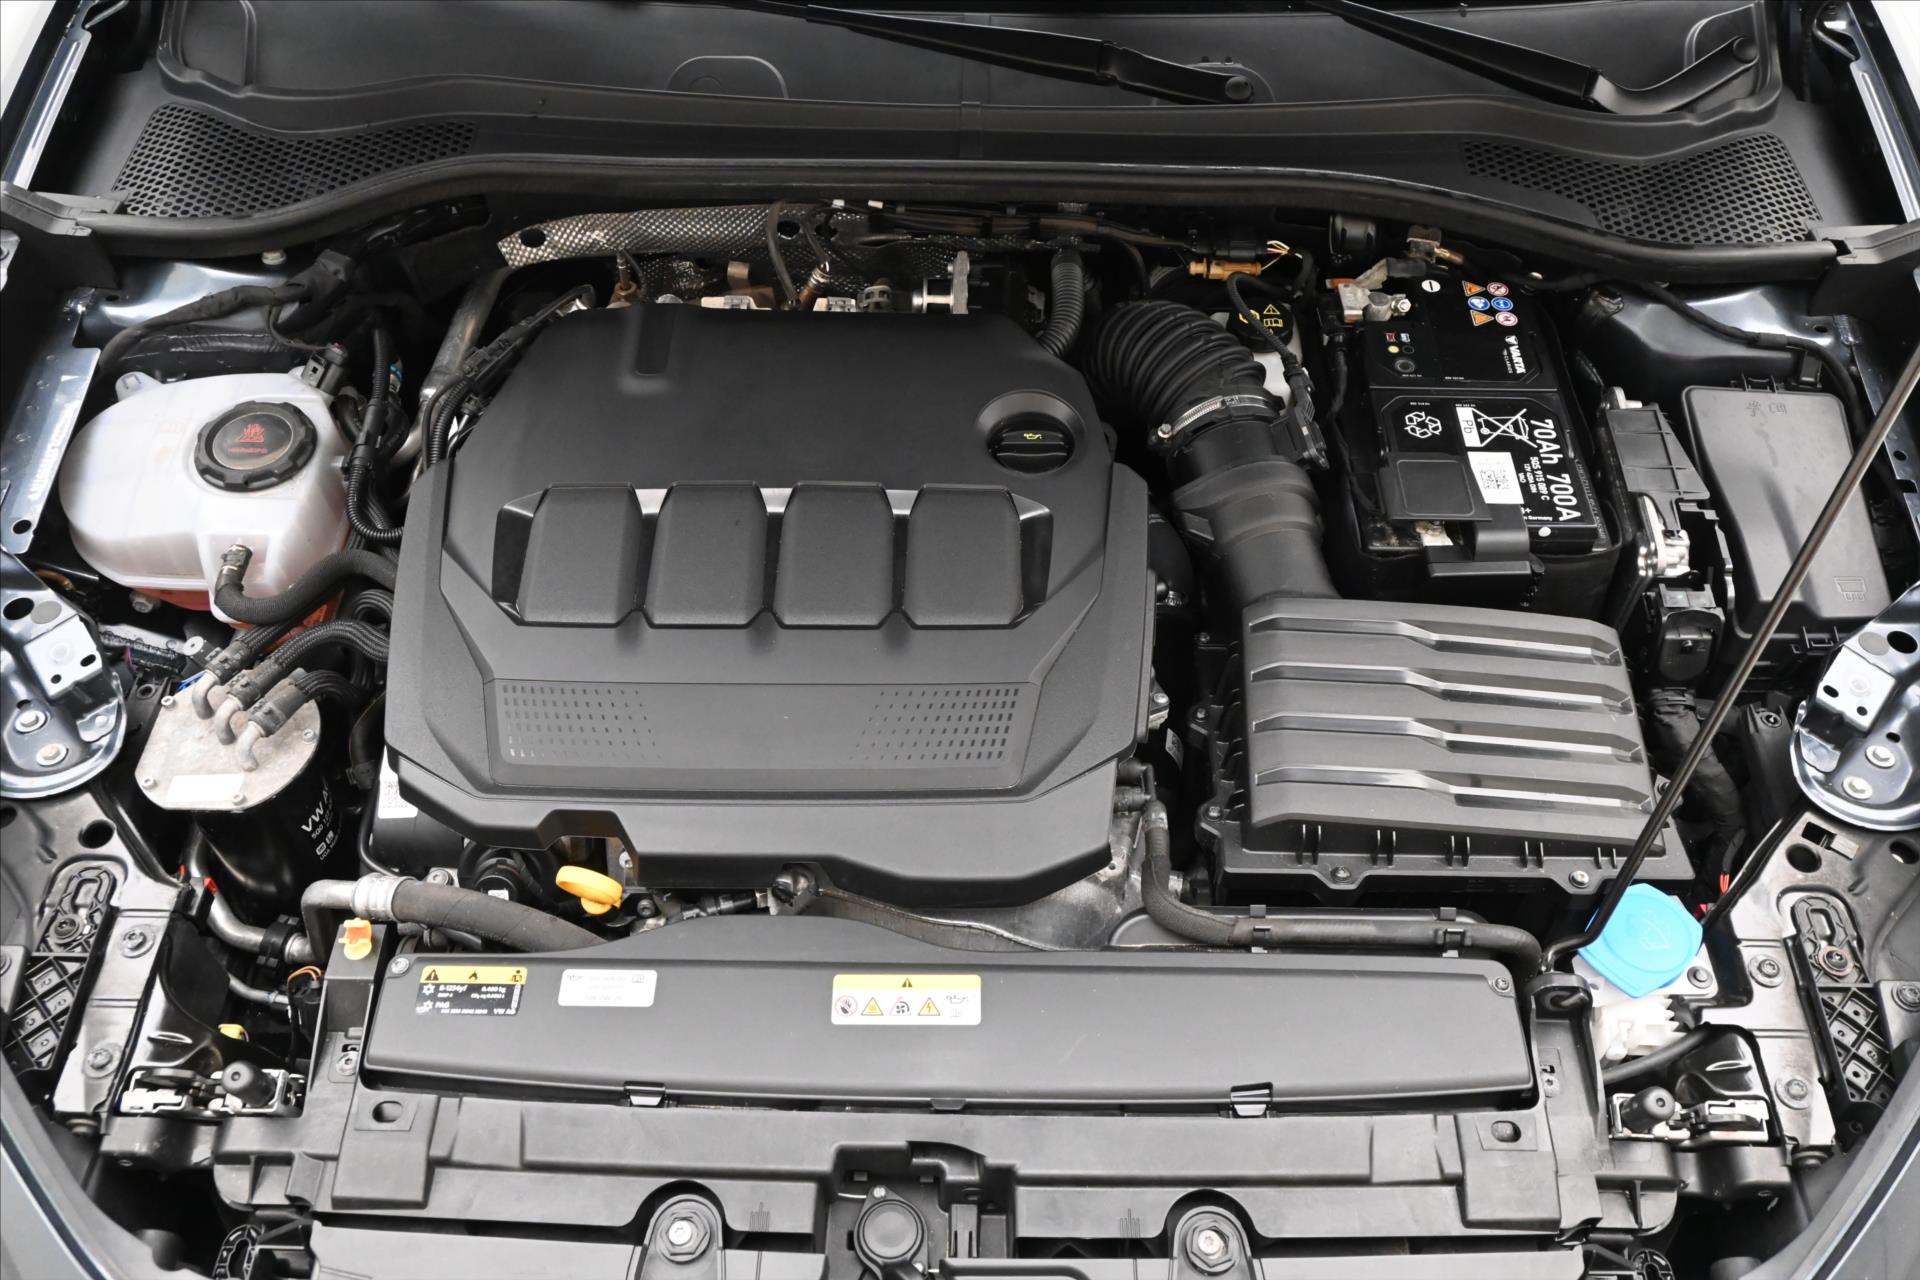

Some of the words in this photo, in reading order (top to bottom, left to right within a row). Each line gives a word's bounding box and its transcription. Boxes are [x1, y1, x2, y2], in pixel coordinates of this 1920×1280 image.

[1509, 345, 1526, 374] VARTA
[1462, 419, 1474, 434] Pb
[1530, 418, 1564, 464] 70Ah
[1533, 469, 1545, 482] 915
[1546, 473, 1582, 522] 700A
[301, 801, 324, 832] VW
